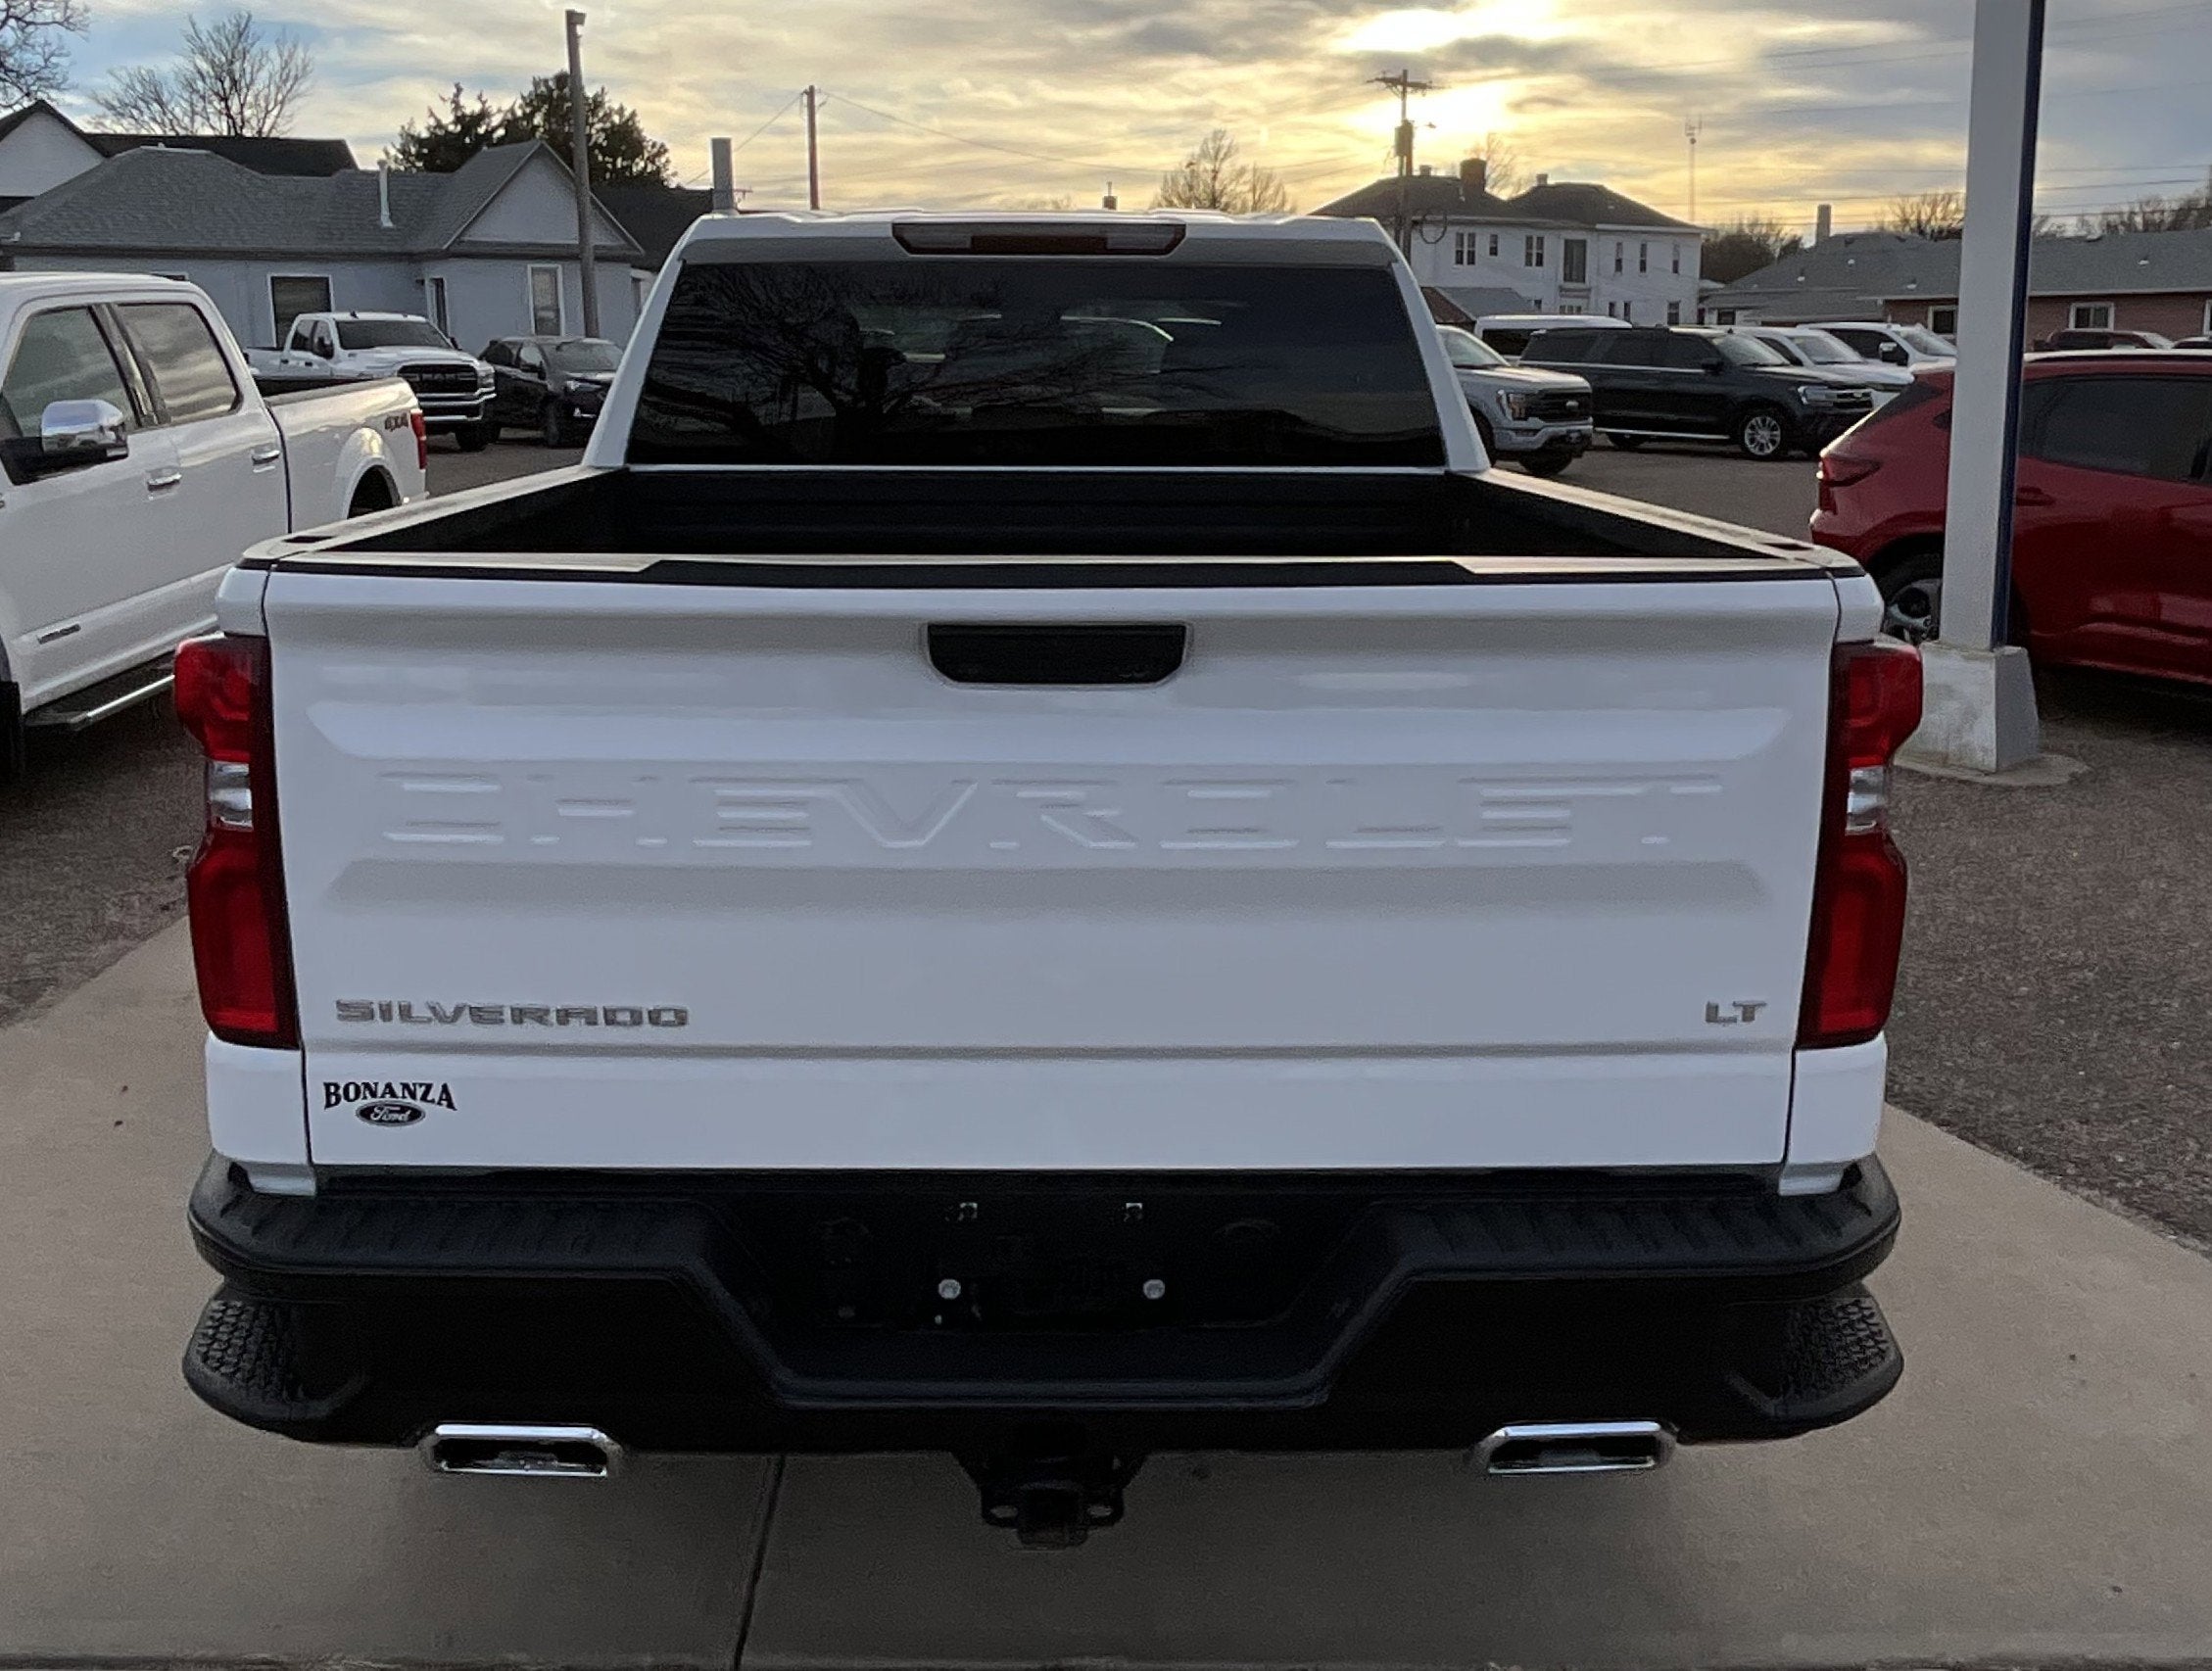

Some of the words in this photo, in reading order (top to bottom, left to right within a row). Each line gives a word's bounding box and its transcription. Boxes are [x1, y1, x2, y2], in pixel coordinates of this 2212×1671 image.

[378, 771, 1722, 851] CHEVROLET
[335, 998, 689, 1027] SILVERADO
[1705, 1000, 1767, 1026] LT
[322, 1080, 457, 1111] BONANZA
[369, 1105, 412, 1122] Ford
